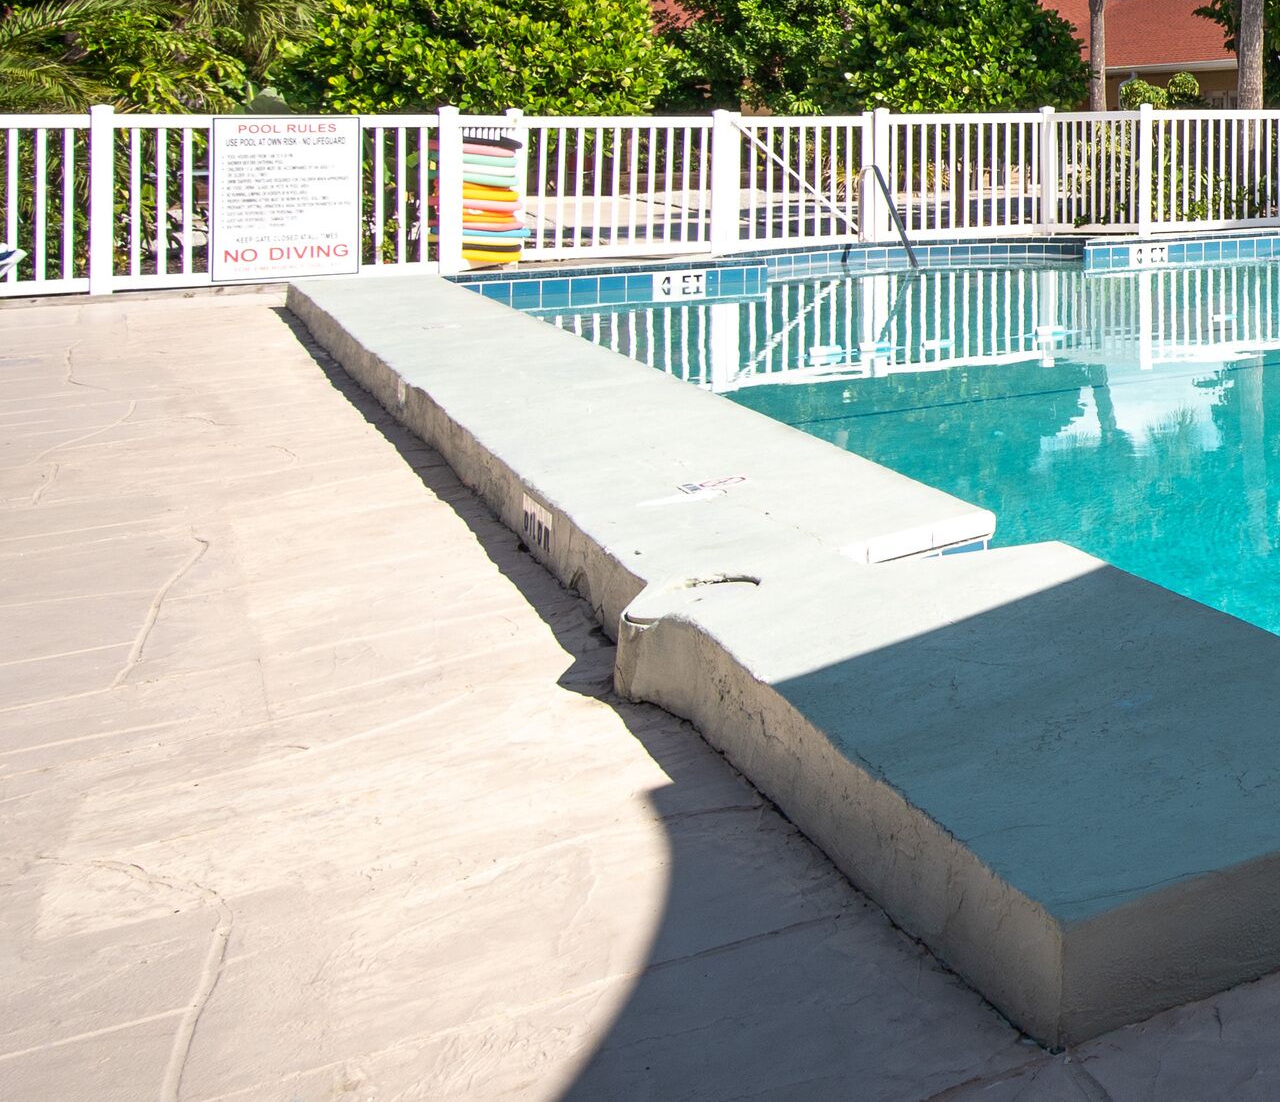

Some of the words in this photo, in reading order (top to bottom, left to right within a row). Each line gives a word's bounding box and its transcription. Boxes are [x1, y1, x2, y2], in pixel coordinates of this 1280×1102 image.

[238, 124, 281, 134] POOL
[286, 123, 337, 133] RULES
[225, 138, 238, 147] USE
[240, 138, 257, 147] POOL
[258, 138, 266, 146] AT
[267, 138, 282, 146] OWN
[283, 137, 297, 146] RISK
[302, 137, 311, 145] NO
[312, 136, 346, 146] LIFEGUARD
[273, 234, 298, 242] CLOSED
[223, 248, 258, 263] NO
[269, 243, 349, 261] DIVING
